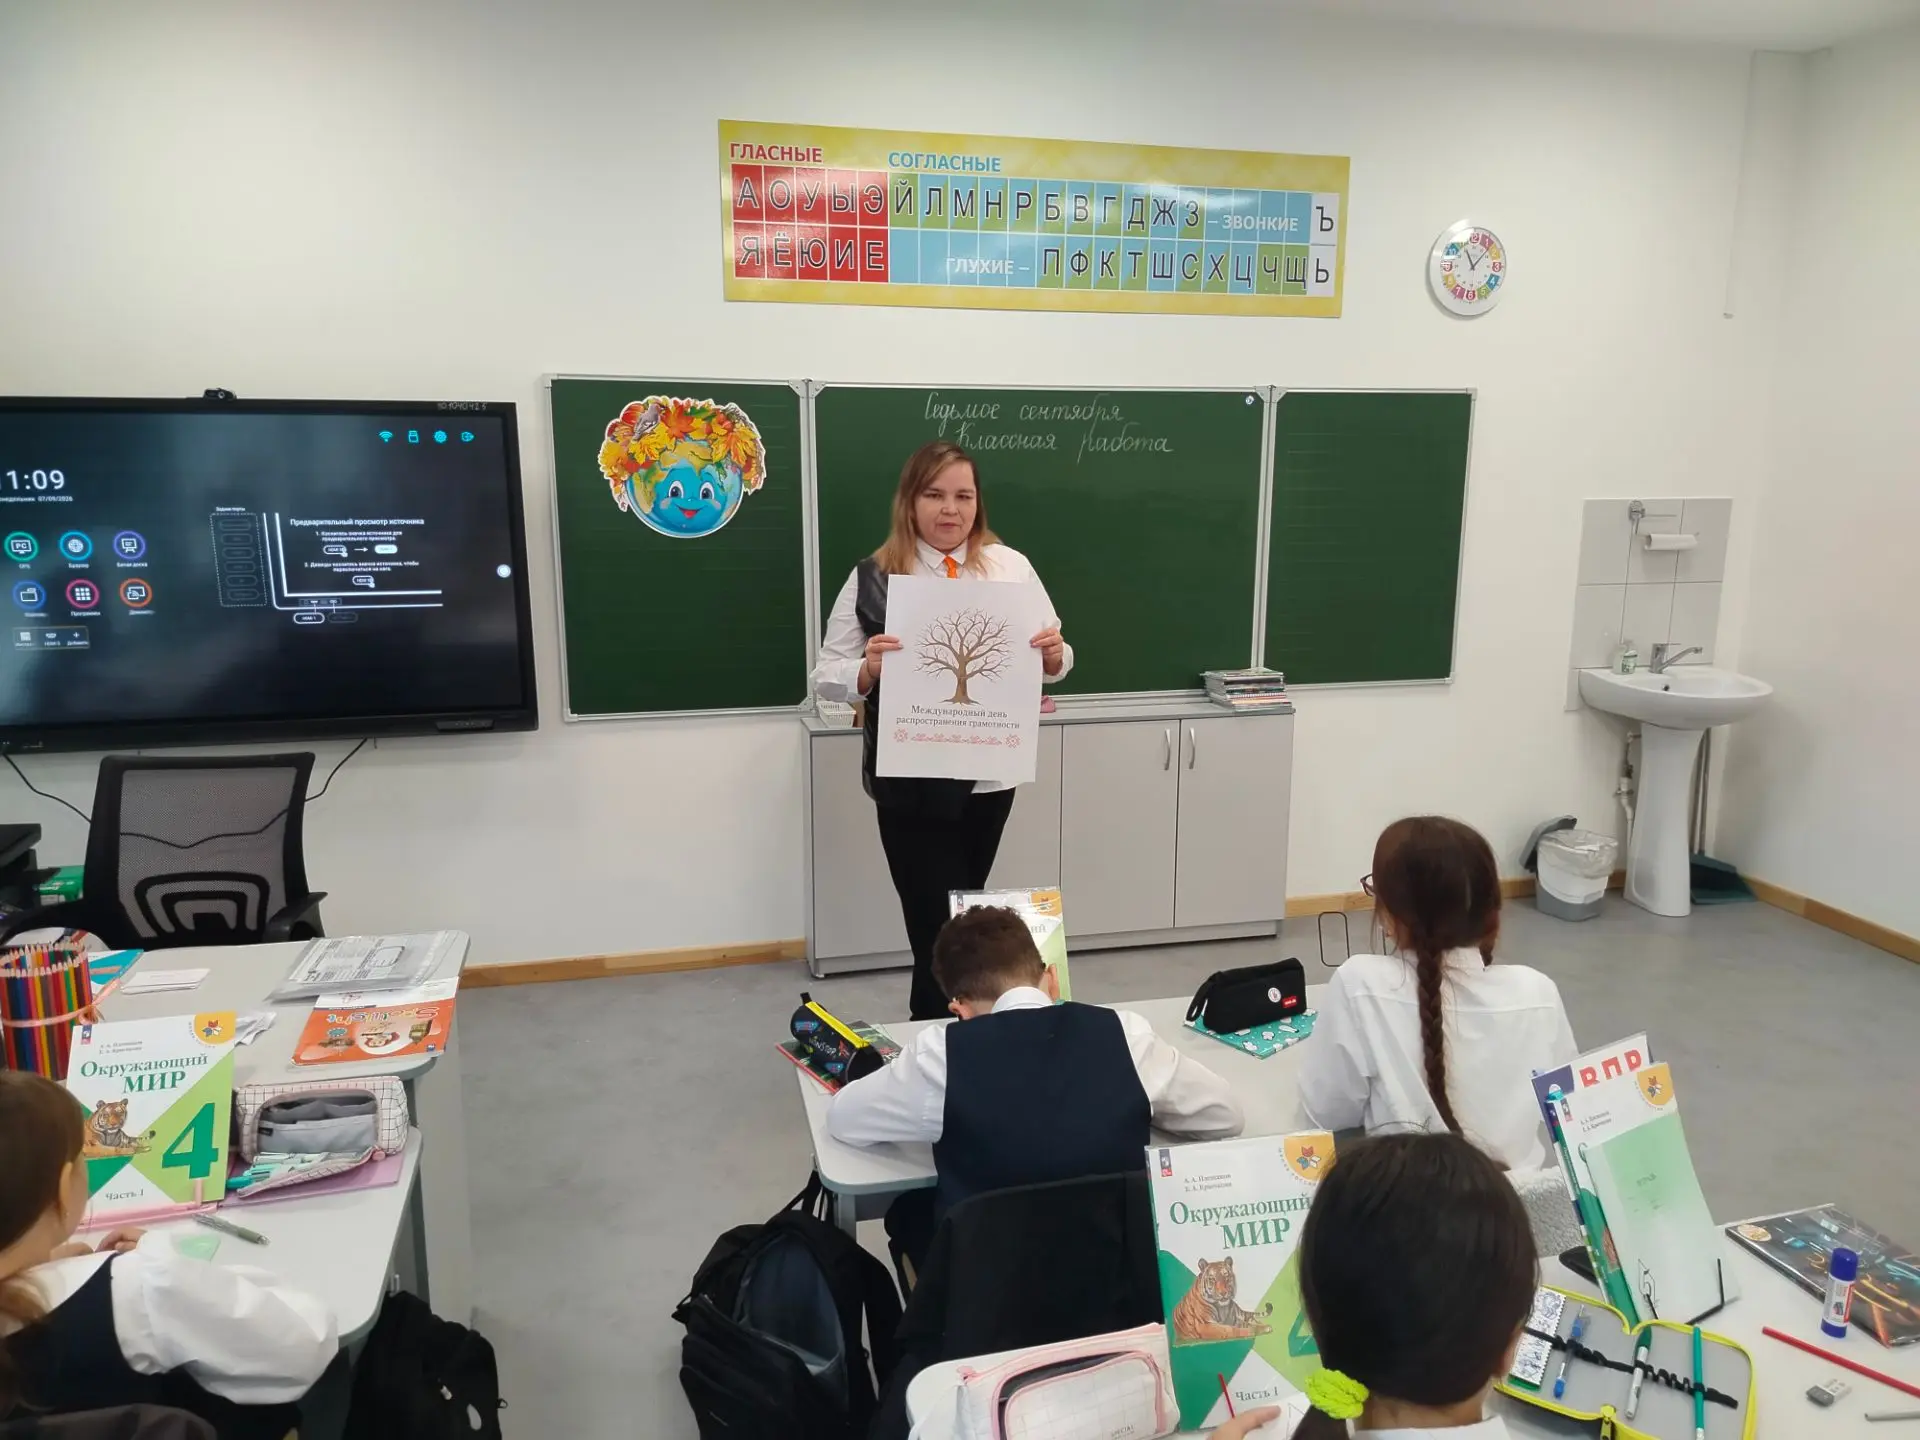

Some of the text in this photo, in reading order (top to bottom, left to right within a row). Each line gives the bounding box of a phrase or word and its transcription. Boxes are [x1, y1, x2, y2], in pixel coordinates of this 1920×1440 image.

[730, 143, 822, 163] ГЛАСНЫЕ
[888, 152, 1001, 172] СОГЛАСНЫЕ
[1222, 214, 1299, 232] ЗВОНКИЕ
[945, 257, 1014, 275] ГЛУХИЕ
[924, 391, 1124, 437] Седьмое сентября
[955, 420, 1174, 464] Классная работа
[0, 469, 65, 490] 1:09
[354, 518, 388, 527] просмотр
[911, 704, 1008, 719] Международный день
[896, 717, 1020, 729] распространения грамотности
[81, 1053, 208, 1078] Окружающий
[123, 1070, 186, 1094] МИР
[161, 1102, 219, 1180] 4
[105, 1191, 137, 1200] Часть
[1169, 1192, 1312, 1226] Окружающий
[1220, 1217, 1291, 1250] МИР
[1235, 1389, 1270, 1402] Часть
